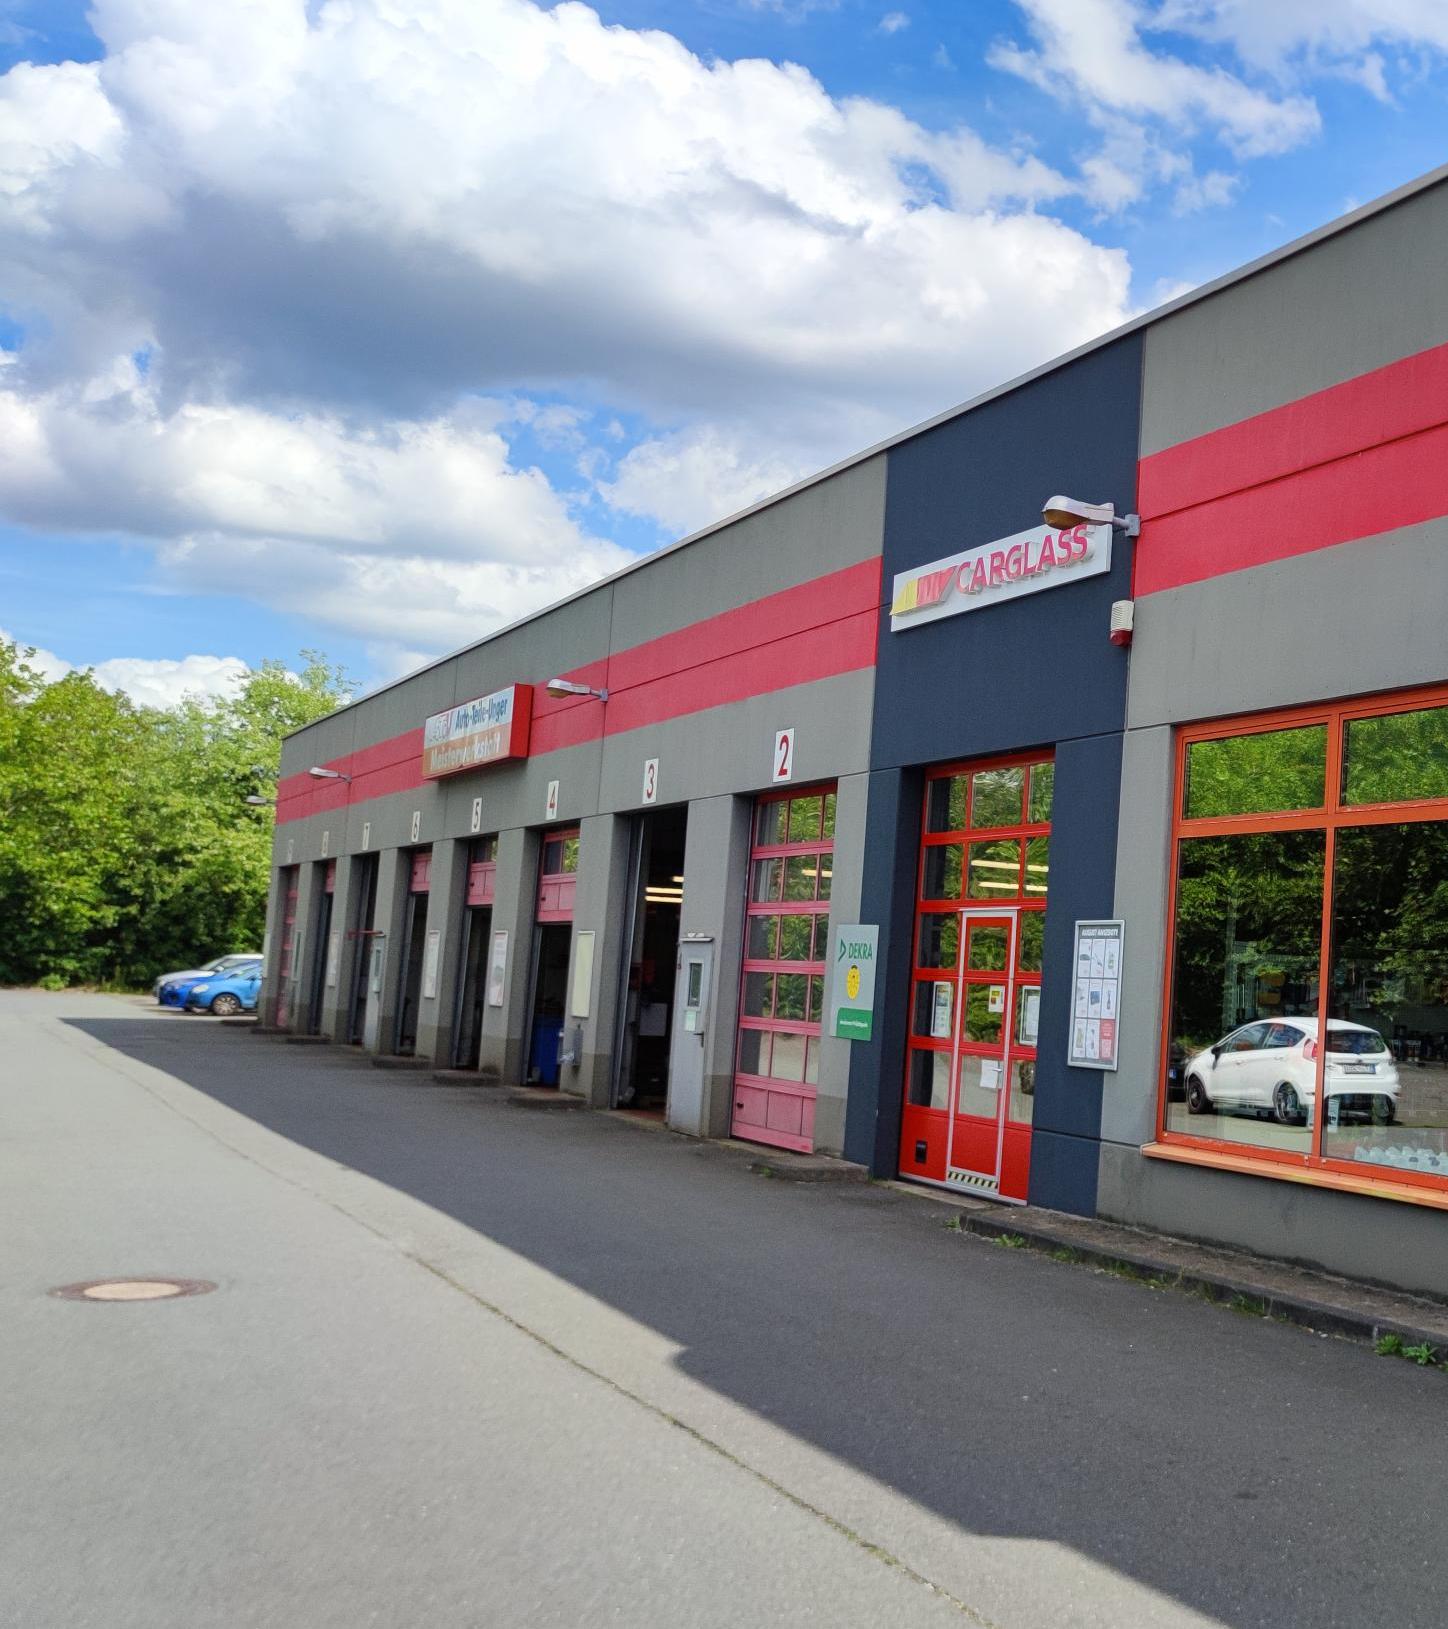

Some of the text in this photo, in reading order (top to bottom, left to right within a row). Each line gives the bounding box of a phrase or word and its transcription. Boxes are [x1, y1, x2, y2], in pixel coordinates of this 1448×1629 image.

[956, 523, 1089, 594] CARGLASS
[777, 734, 789, 777] 2
[646, 763, 655, 799] 3
[548, 785, 557, 809] 4
[473, 802, 480, 829] 5
[848, 942, 873, 960] DEKRA
